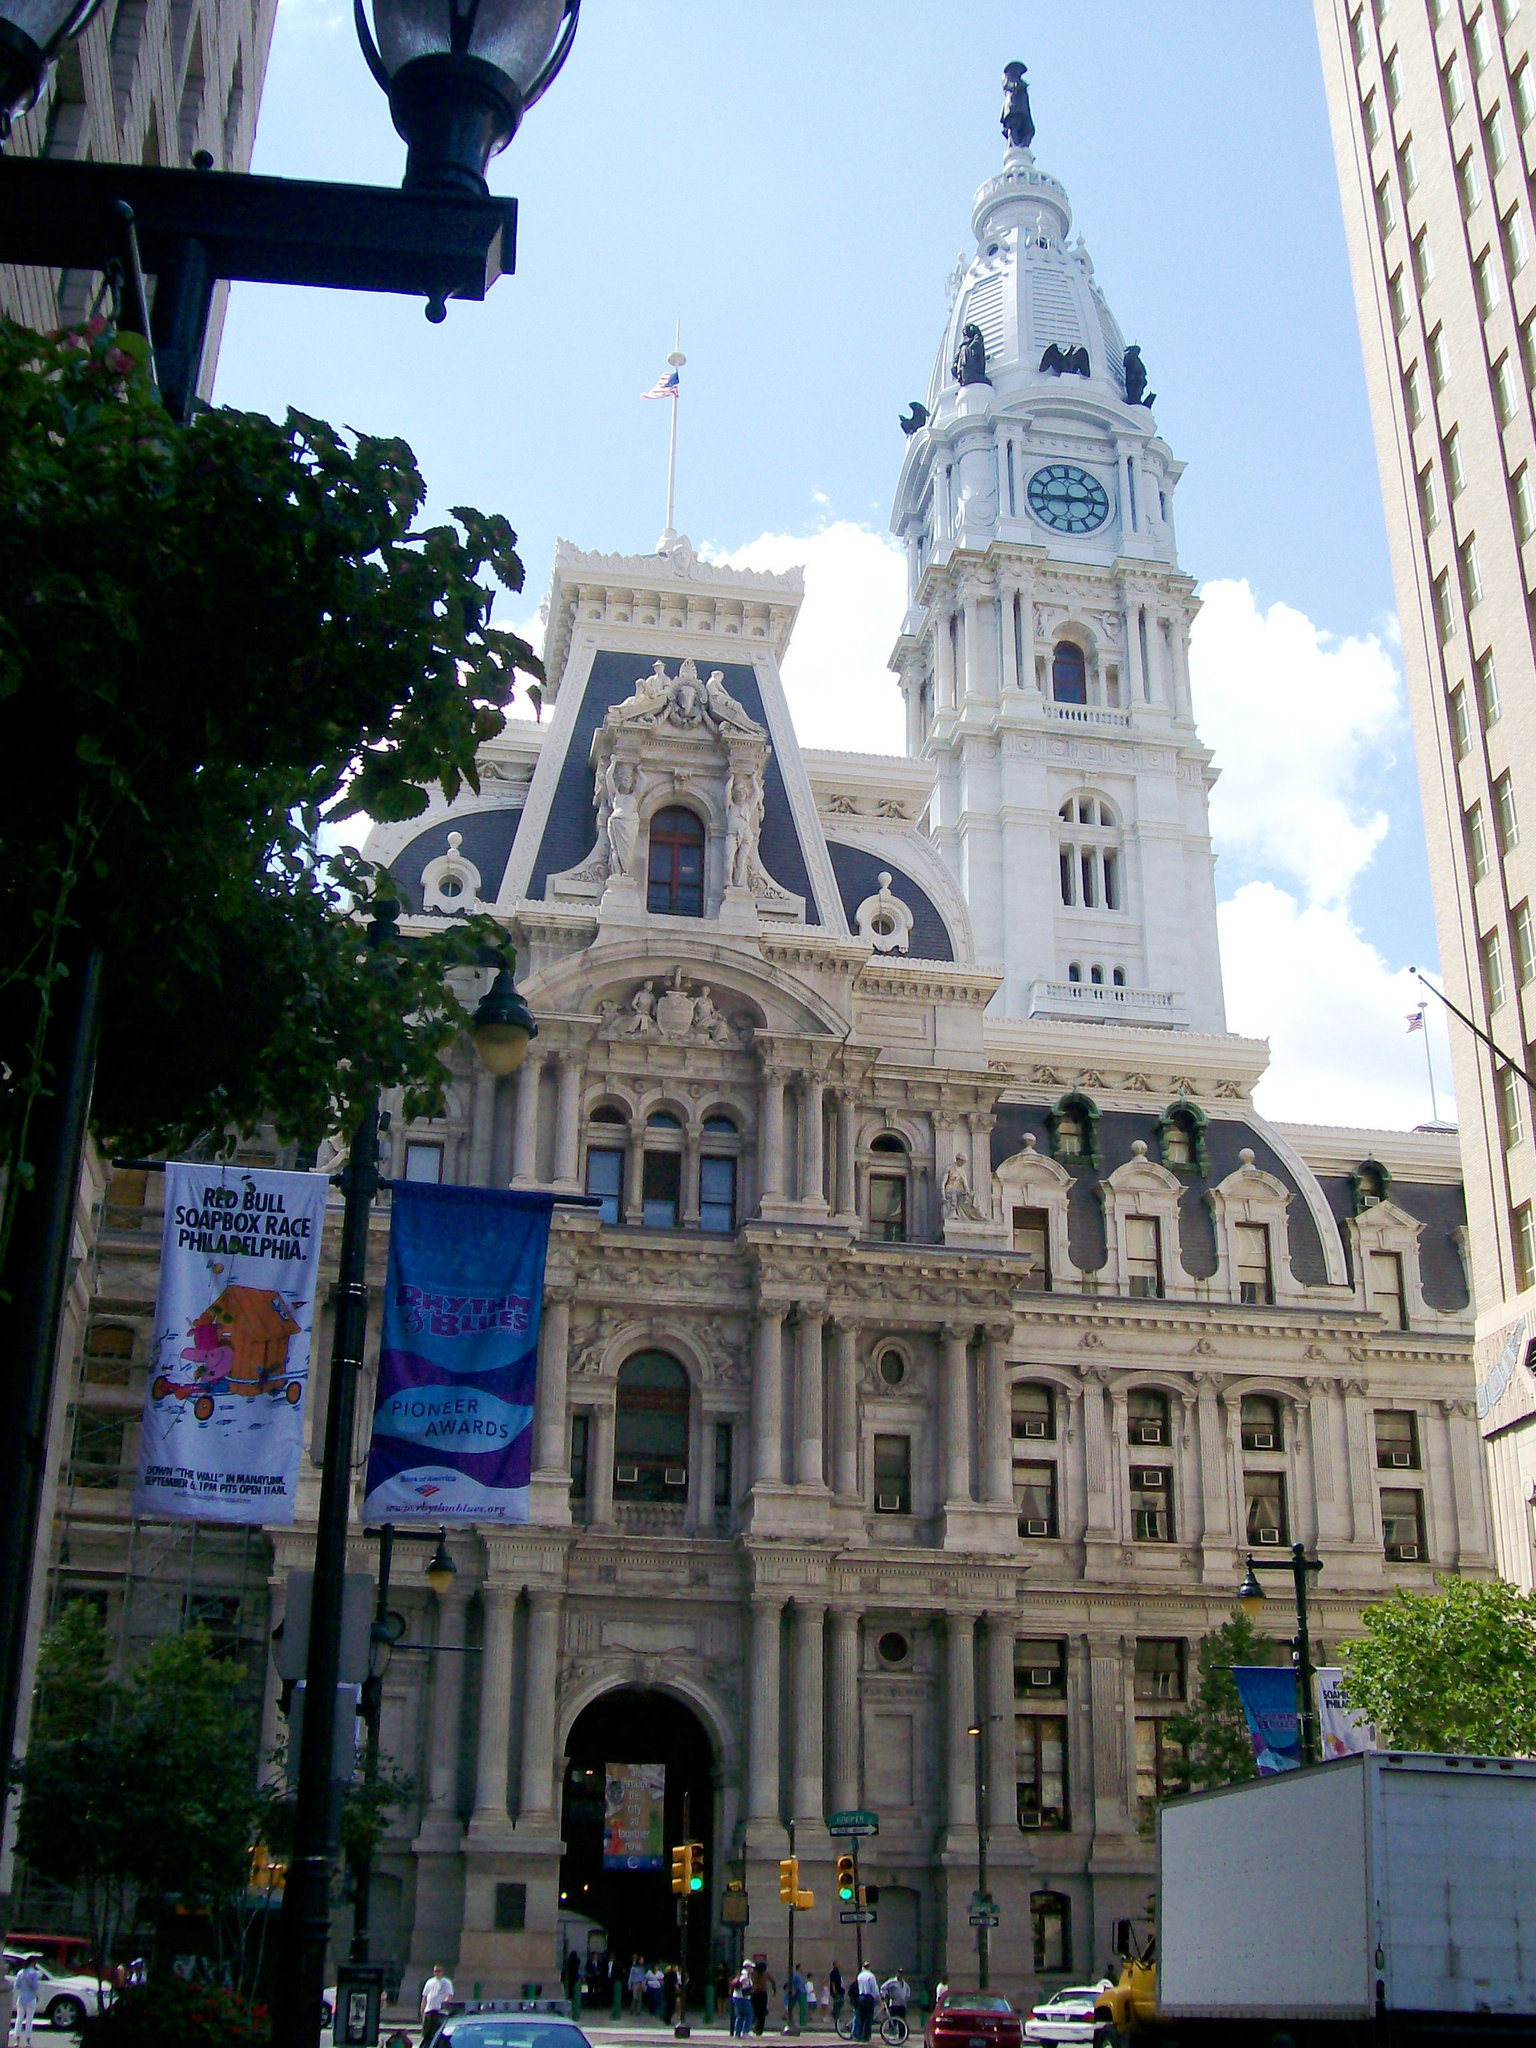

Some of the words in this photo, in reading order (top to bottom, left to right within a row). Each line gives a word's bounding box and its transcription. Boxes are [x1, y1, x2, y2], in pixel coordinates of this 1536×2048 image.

[203, 1187, 239, 1209] RED
[242, 1191, 286, 1214] BULL
[175, 1205, 261, 1233] SOAPBOX
[265, 1216, 311, 1237] RACE
[178, 1229, 307, 1260] PHILADELPHIA.
[395, 1284, 531, 1316] RHYTHM
[429, 1308, 529, 1337] BLUES
[391, 1399, 479, 1417] PIONEER
[425, 1420, 509, 1439] AWARDS
[144, 1476, 188, 1488] SEPTEMBER
[199, 1482, 217, 1492] 1PM
[219, 1484, 237, 1494] PITS
[239, 1485, 262, 1495] OPEN
[146, 1465, 173, 1477] DOWN
[196, 1471, 224, 1482] WALL"
[225, 1474, 235, 1484] IN
